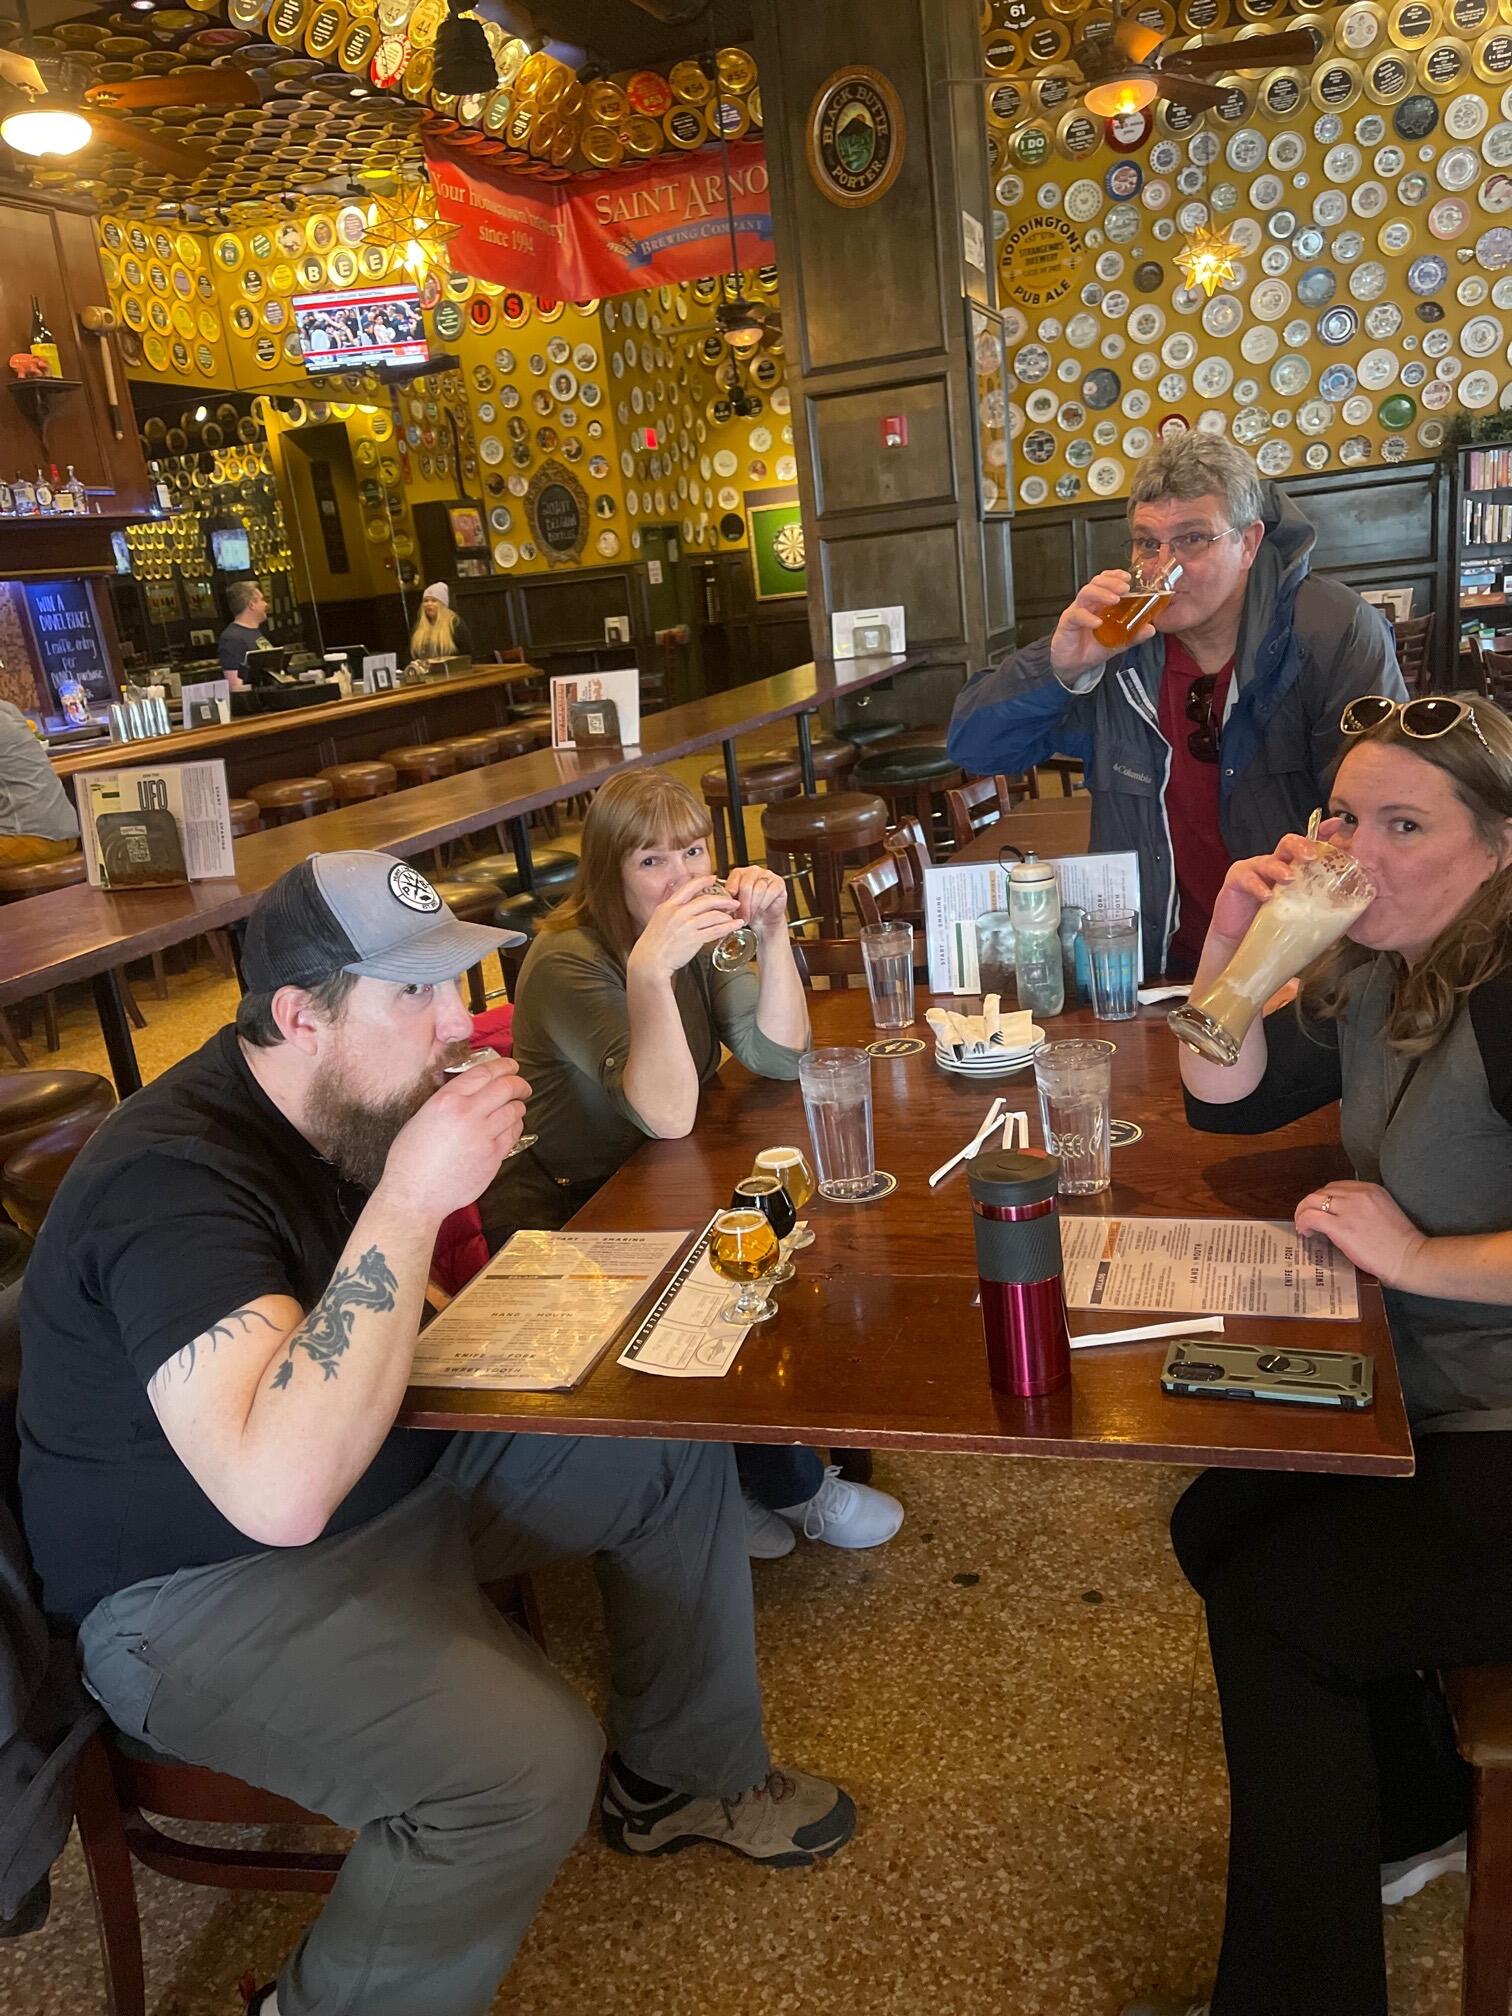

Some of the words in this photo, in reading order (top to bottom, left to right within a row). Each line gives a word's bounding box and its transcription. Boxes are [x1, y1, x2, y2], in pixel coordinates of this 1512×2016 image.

[1009, 4, 1026, 17] 61
[823, 87, 854, 145] BLACK
[856, 86, 889, 137] BUTTE
[1027, 138, 1044, 150] DO
[831, 160, 884, 188] PORTER
[431, 170, 466, 204] Your
[595, 182, 680, 226] SAINT
[479, 219, 510, 248] since
[640, 228, 699, 256] BREWING
[700, 218, 763, 240] COMPANY
[1002, 216, 1081, 267] BODDINGTONS
[307, 266, 320, 282] B
[337, 260, 350, 276] E
[368, 253, 381, 270] E
[1013, 286, 1040, 305] PUB
[1045, 279, 1071, 303] ALE
[473, 304, 491, 322] U
[506, 297, 520, 314] S
[36, 596, 56, 613] WIN
[56, 593, 65, 611] A
[39, 612, 67, 632] DUVEL
[1118, 765, 1152, 784] Columbia
[137, 778, 168, 811] UFO
[936, 896, 944, 928] SHARING
[689, 1240, 708, 1264] BACKS
[1191, 1243, 1202, 1260] MOUTH
[1284, 1246, 1293, 1260] FORK
[1314, 1249, 1324, 1266] TOOTH
[669, 1276, 684, 1297] TRAY
[1095, 1273, 1106, 1291] SALADS
[1190, 1267, 1199, 1284] HAND
[1284, 1269, 1293, 1287] KNIFE
[1314, 1268, 1324, 1287] SWEET
[643, 1302, 668, 1335] TABLES
[632, 1339, 643, 1351] UP
